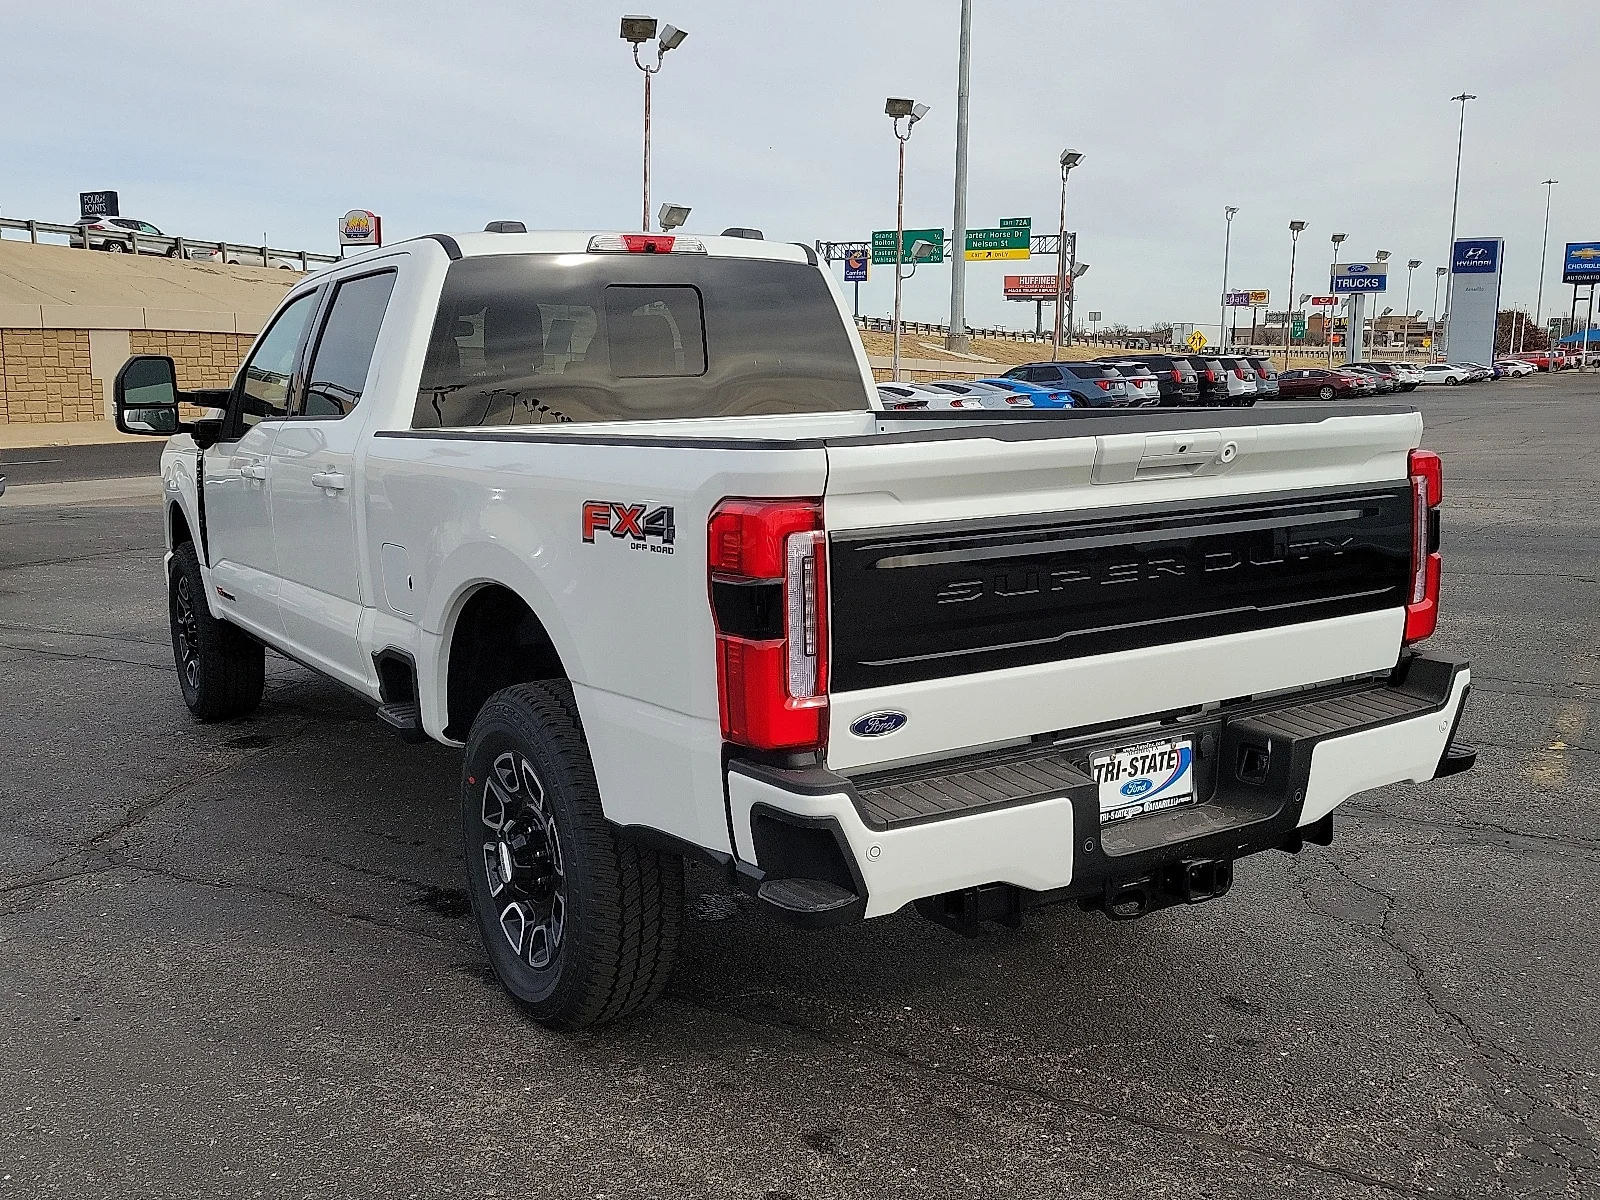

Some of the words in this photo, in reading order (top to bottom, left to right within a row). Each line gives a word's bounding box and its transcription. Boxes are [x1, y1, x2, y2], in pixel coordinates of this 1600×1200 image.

[84, 203, 107, 213] POINTS
[989, 231, 1011, 239] Horse
[1019, 276, 1056, 285] HUFFINES
[1336, 278, 1379, 288] TRUCKS
[582, 500, 676, 545] FX4
[630, 542, 648, 551] OFF
[650, 544, 674, 555] ROAD
[937, 558, 1186, 604] SUPER
[1205, 536, 1354, 572] DUTY
[1094, 749, 1178, 784] TRI-STATE
